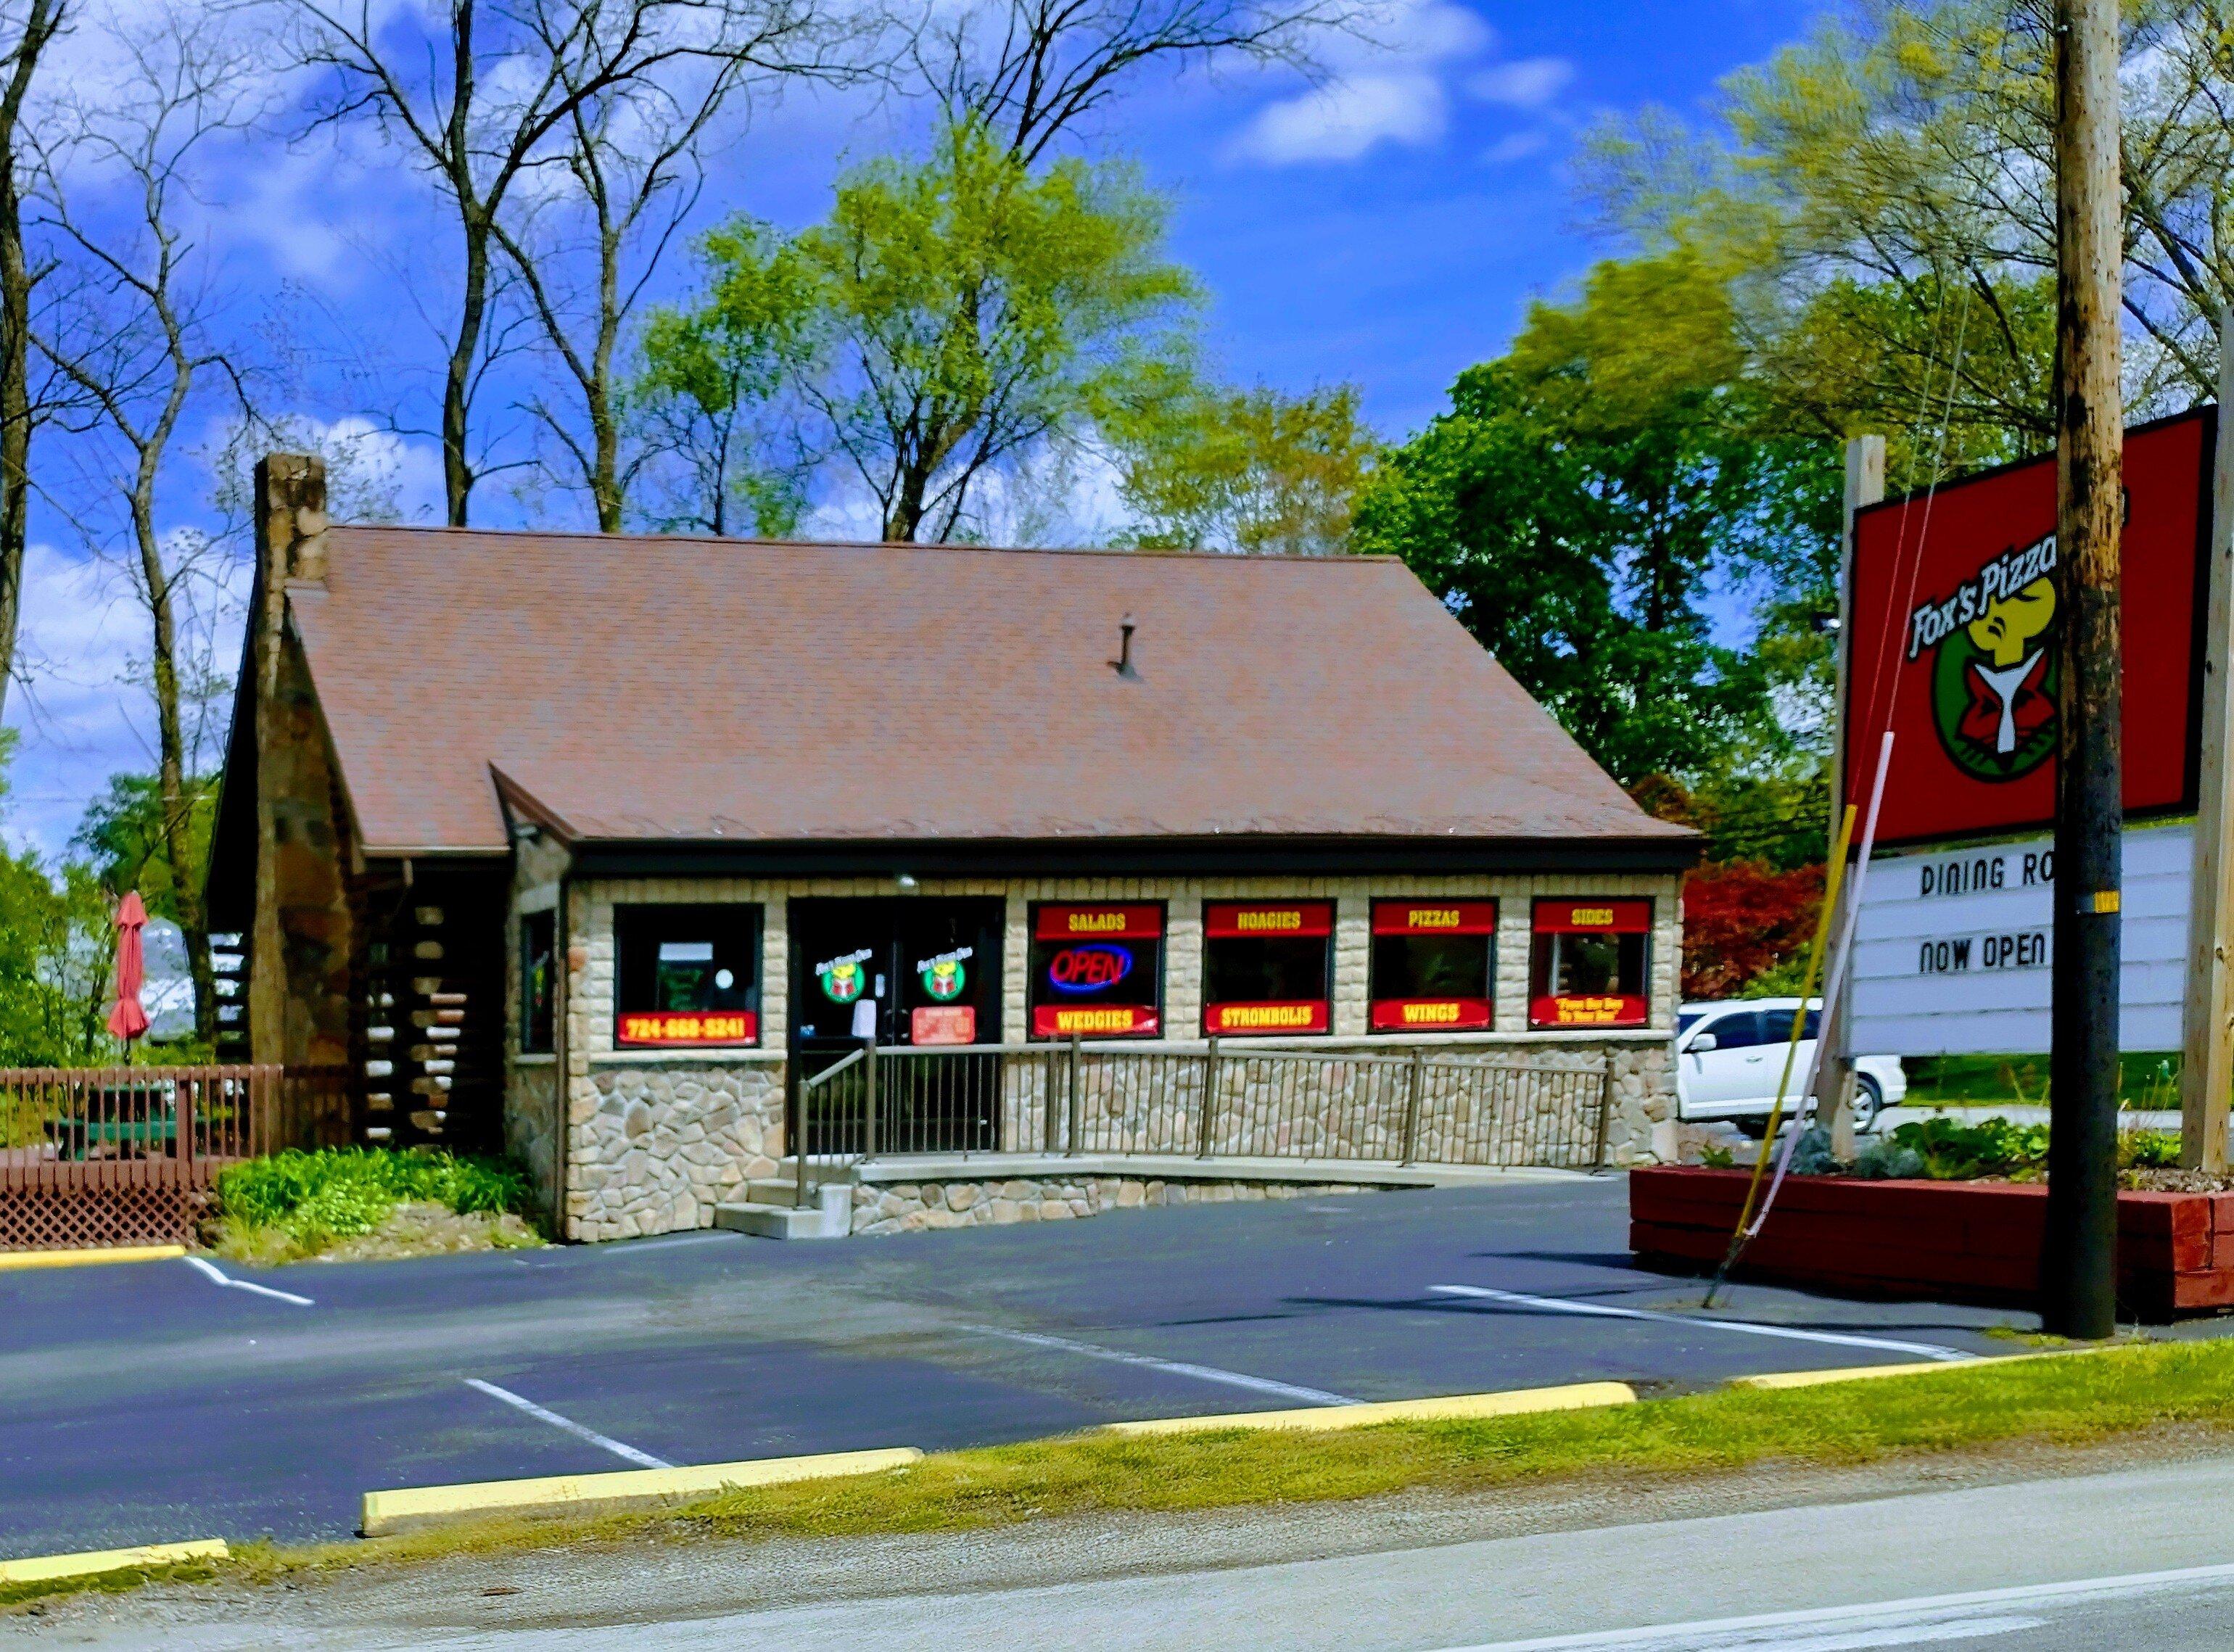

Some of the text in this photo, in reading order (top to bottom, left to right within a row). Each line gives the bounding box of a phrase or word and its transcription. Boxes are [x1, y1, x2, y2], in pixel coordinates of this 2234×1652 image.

[1908, 534, 2057, 659] Fox's Pizza
[1921, 850, 2056, 896] DINING RO
[1068, 912, 1126, 932] SALADS
[1237, 911, 1301, 930] HOAGIES
[1409, 909, 1460, 928] PIZZAS
[1920, 933, 2045, 973] NOW OPEN
[1050, 949, 1125, 985] OPEN
[1056, 1009, 1134, 1032] WEDGIES
[1221, 1005, 1313, 1028] STROMBOLIS
[1403, 1002, 1461, 1023] WINGS
